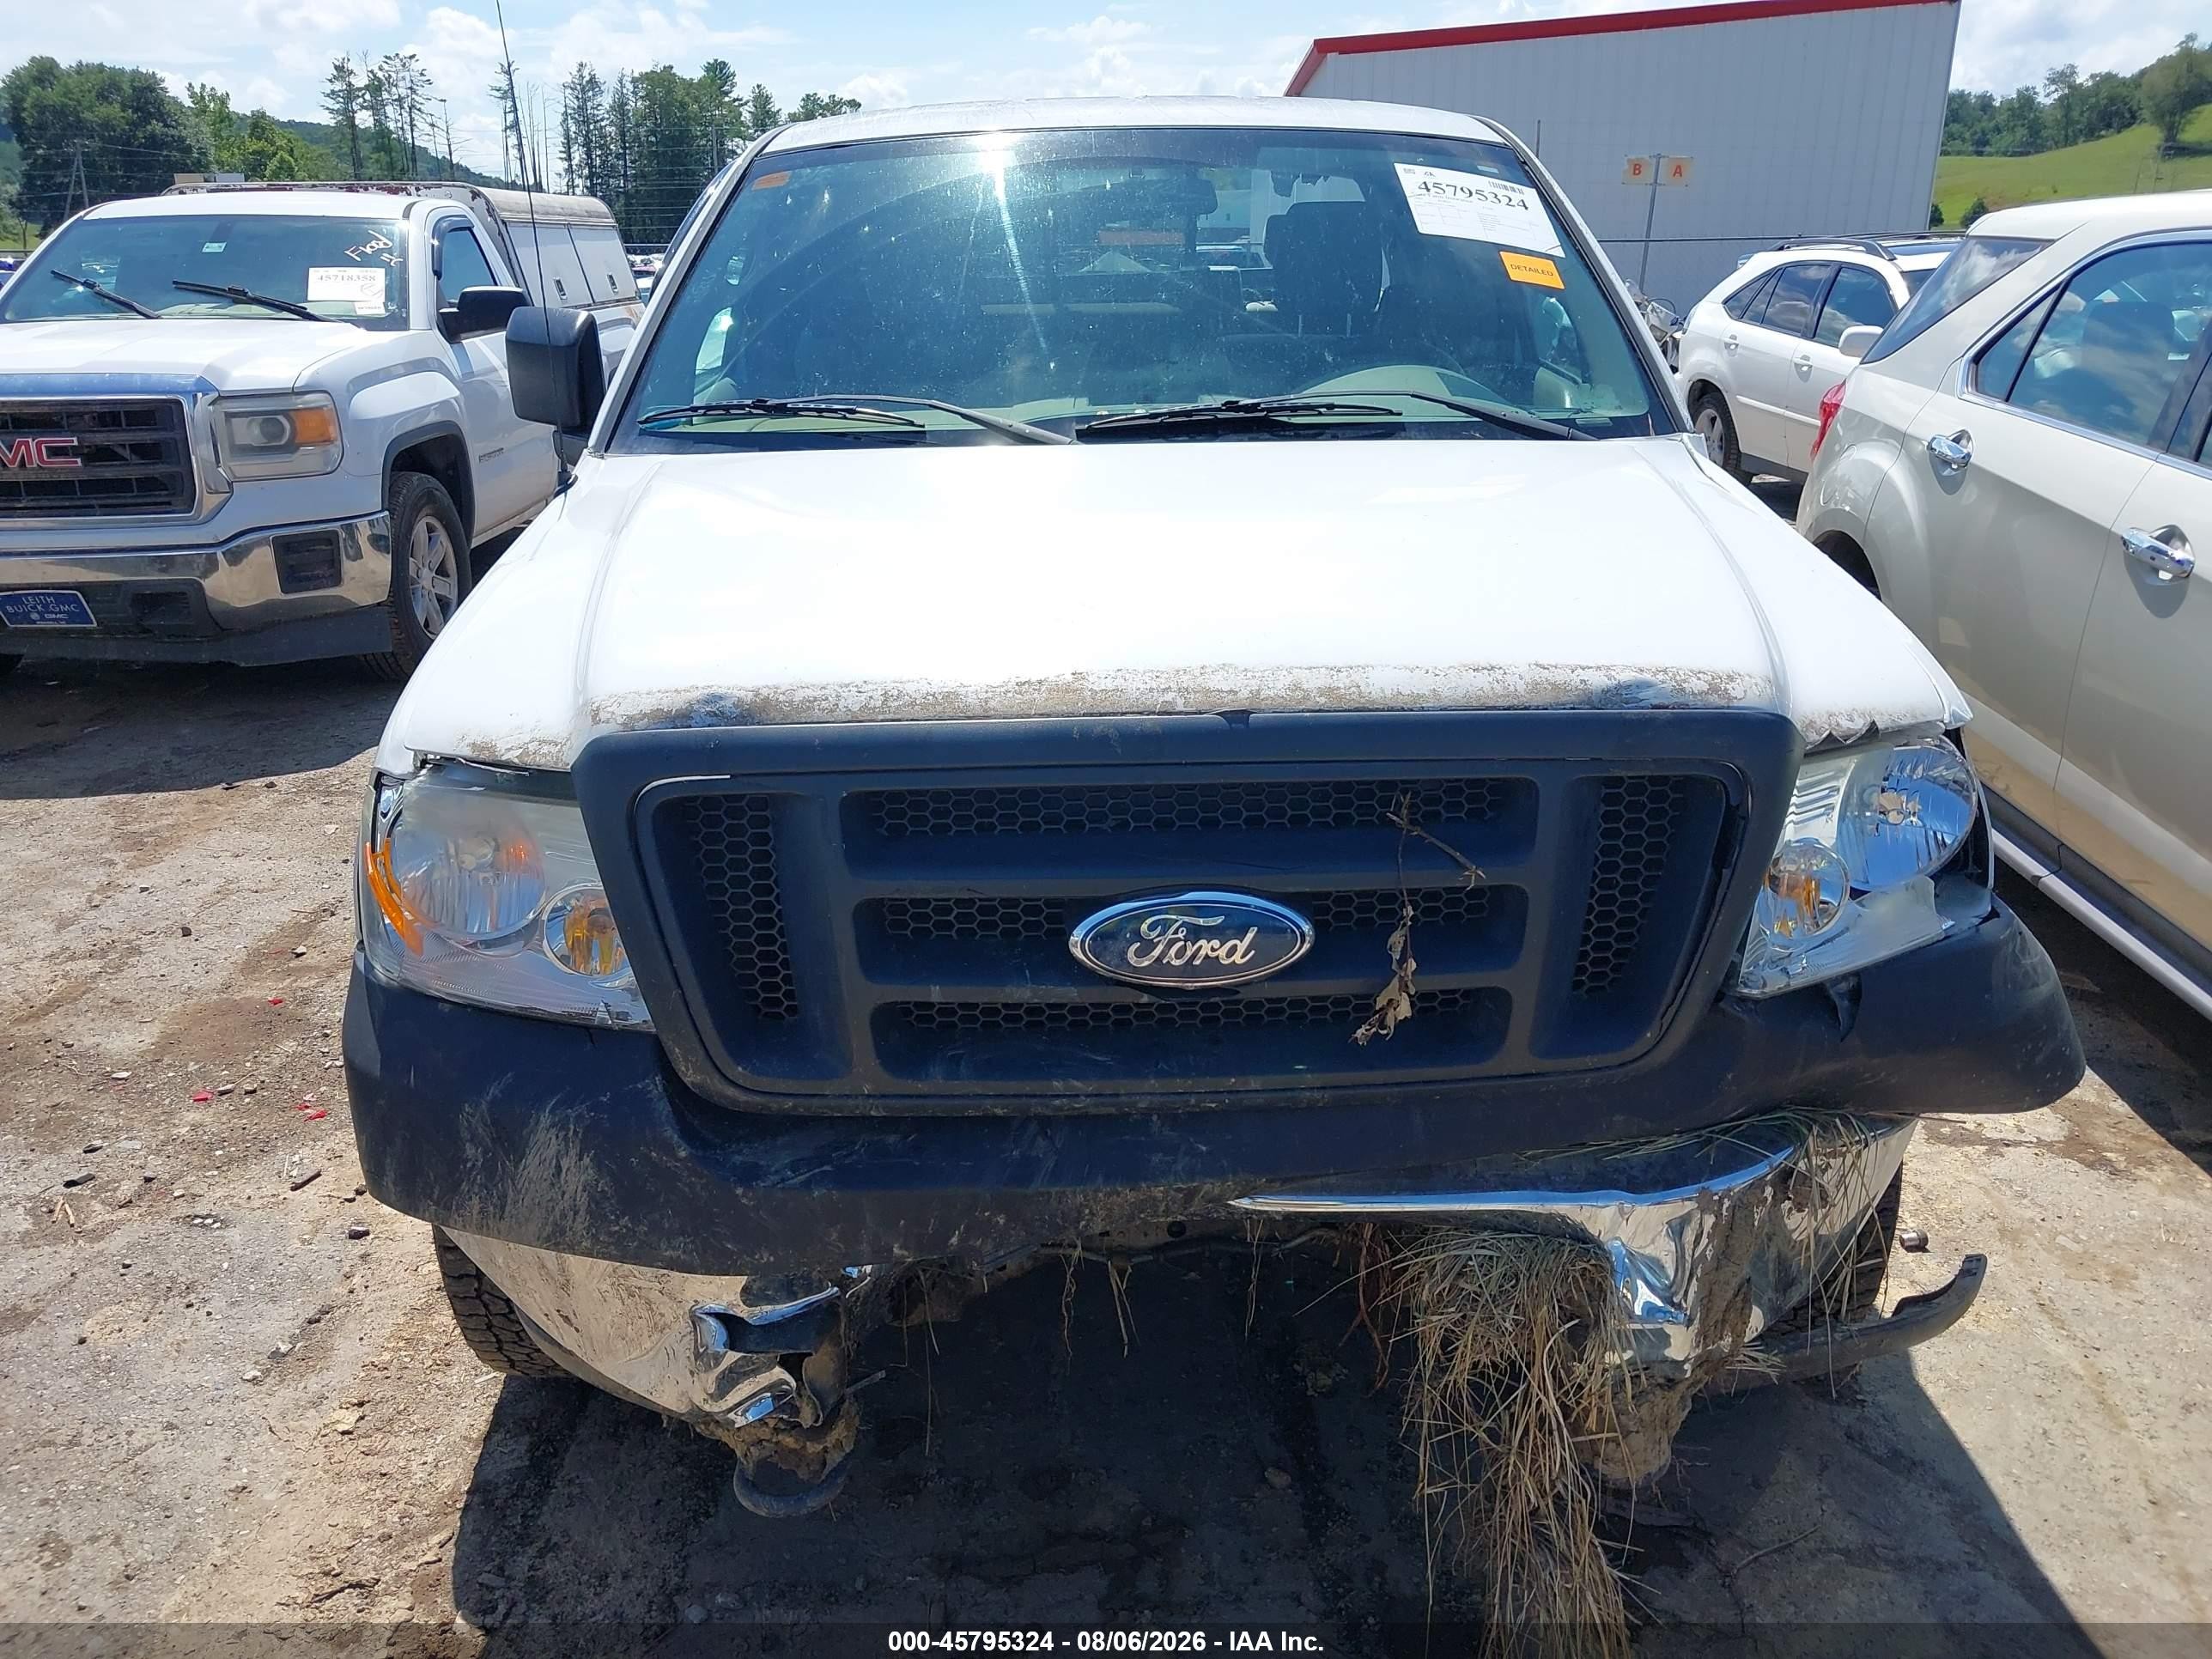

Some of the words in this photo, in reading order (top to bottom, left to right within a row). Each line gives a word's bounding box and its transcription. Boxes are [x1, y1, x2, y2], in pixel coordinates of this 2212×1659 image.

[1633, 163, 1642, 175] B
[1673, 165, 1682, 177] A
[1418, 181, 1529, 210] 45795324
[1510, 264, 1553, 276] DETAILED
[22, 596, 55, 605] LEITH
[6, 605, 46, 613] BUICK
[49, 604, 80, 612] GMC
[1127, 915, 1257, 967] Ford
